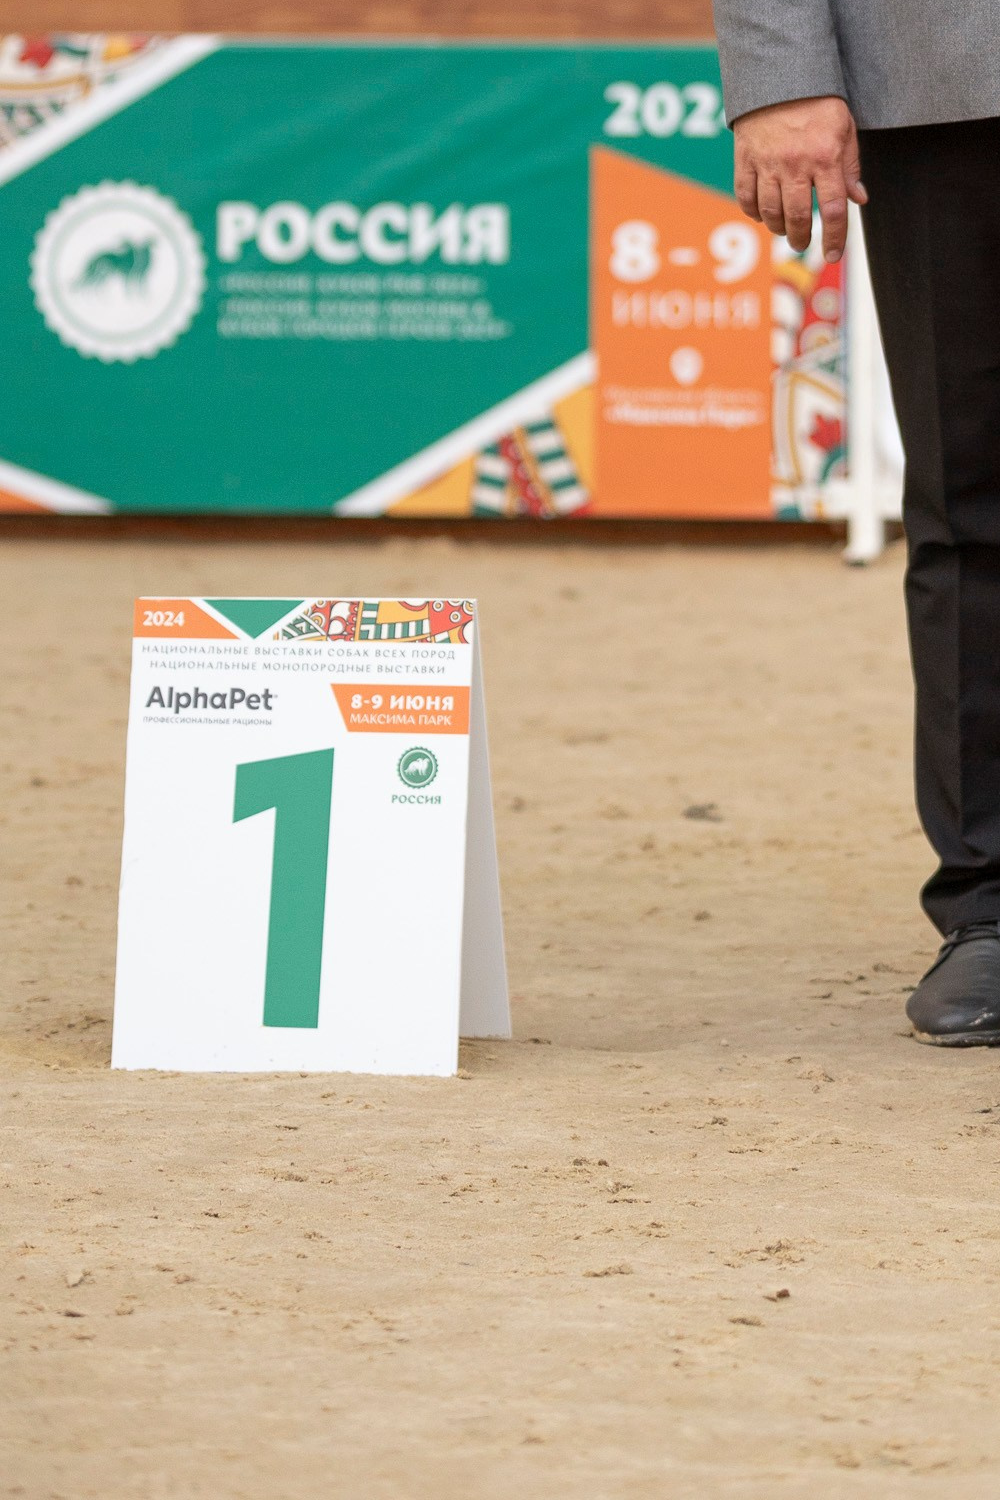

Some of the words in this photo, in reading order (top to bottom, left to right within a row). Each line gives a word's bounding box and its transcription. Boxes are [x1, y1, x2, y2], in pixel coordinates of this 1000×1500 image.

[216, 201, 510, 264] РОССИЯ
[611, 290, 761, 330] ИЮНЯ
[143, 610, 185, 627] 2024
[142, 645, 248, 655] НАЦИОНАЛЬНЫЕ
[254, 647, 322, 657] ВЫСТАВКИ
[327, 648, 369, 658] СОБАК
[374, 649, 406, 659] ВСЕХ
[411, 650, 455, 661] ПОРОД
[150, 660, 257, 671] НАЦИОНАЛЬНЫЕ
[262, 663, 372, 674] МОНОПОРОДНЫЕ
[377, 665, 445, 675] ВЫСТАВКИ
[146, 686, 273, 714] AlphaPet
[350, 694, 383, 709] 8-9
[389, 695, 454, 711] ИЮНЯ
[143, 716, 230, 725] ПРОФЕССИОНАЛЬНЫЕ
[232, 718, 272, 726] РАЦИОНЫ
[350, 713, 416, 726] МАКСИМА
[418, 714, 452, 726] ПАРК
[391, 795, 441, 805] РОССИЯ
[233, 748, 334, 1028] 1
